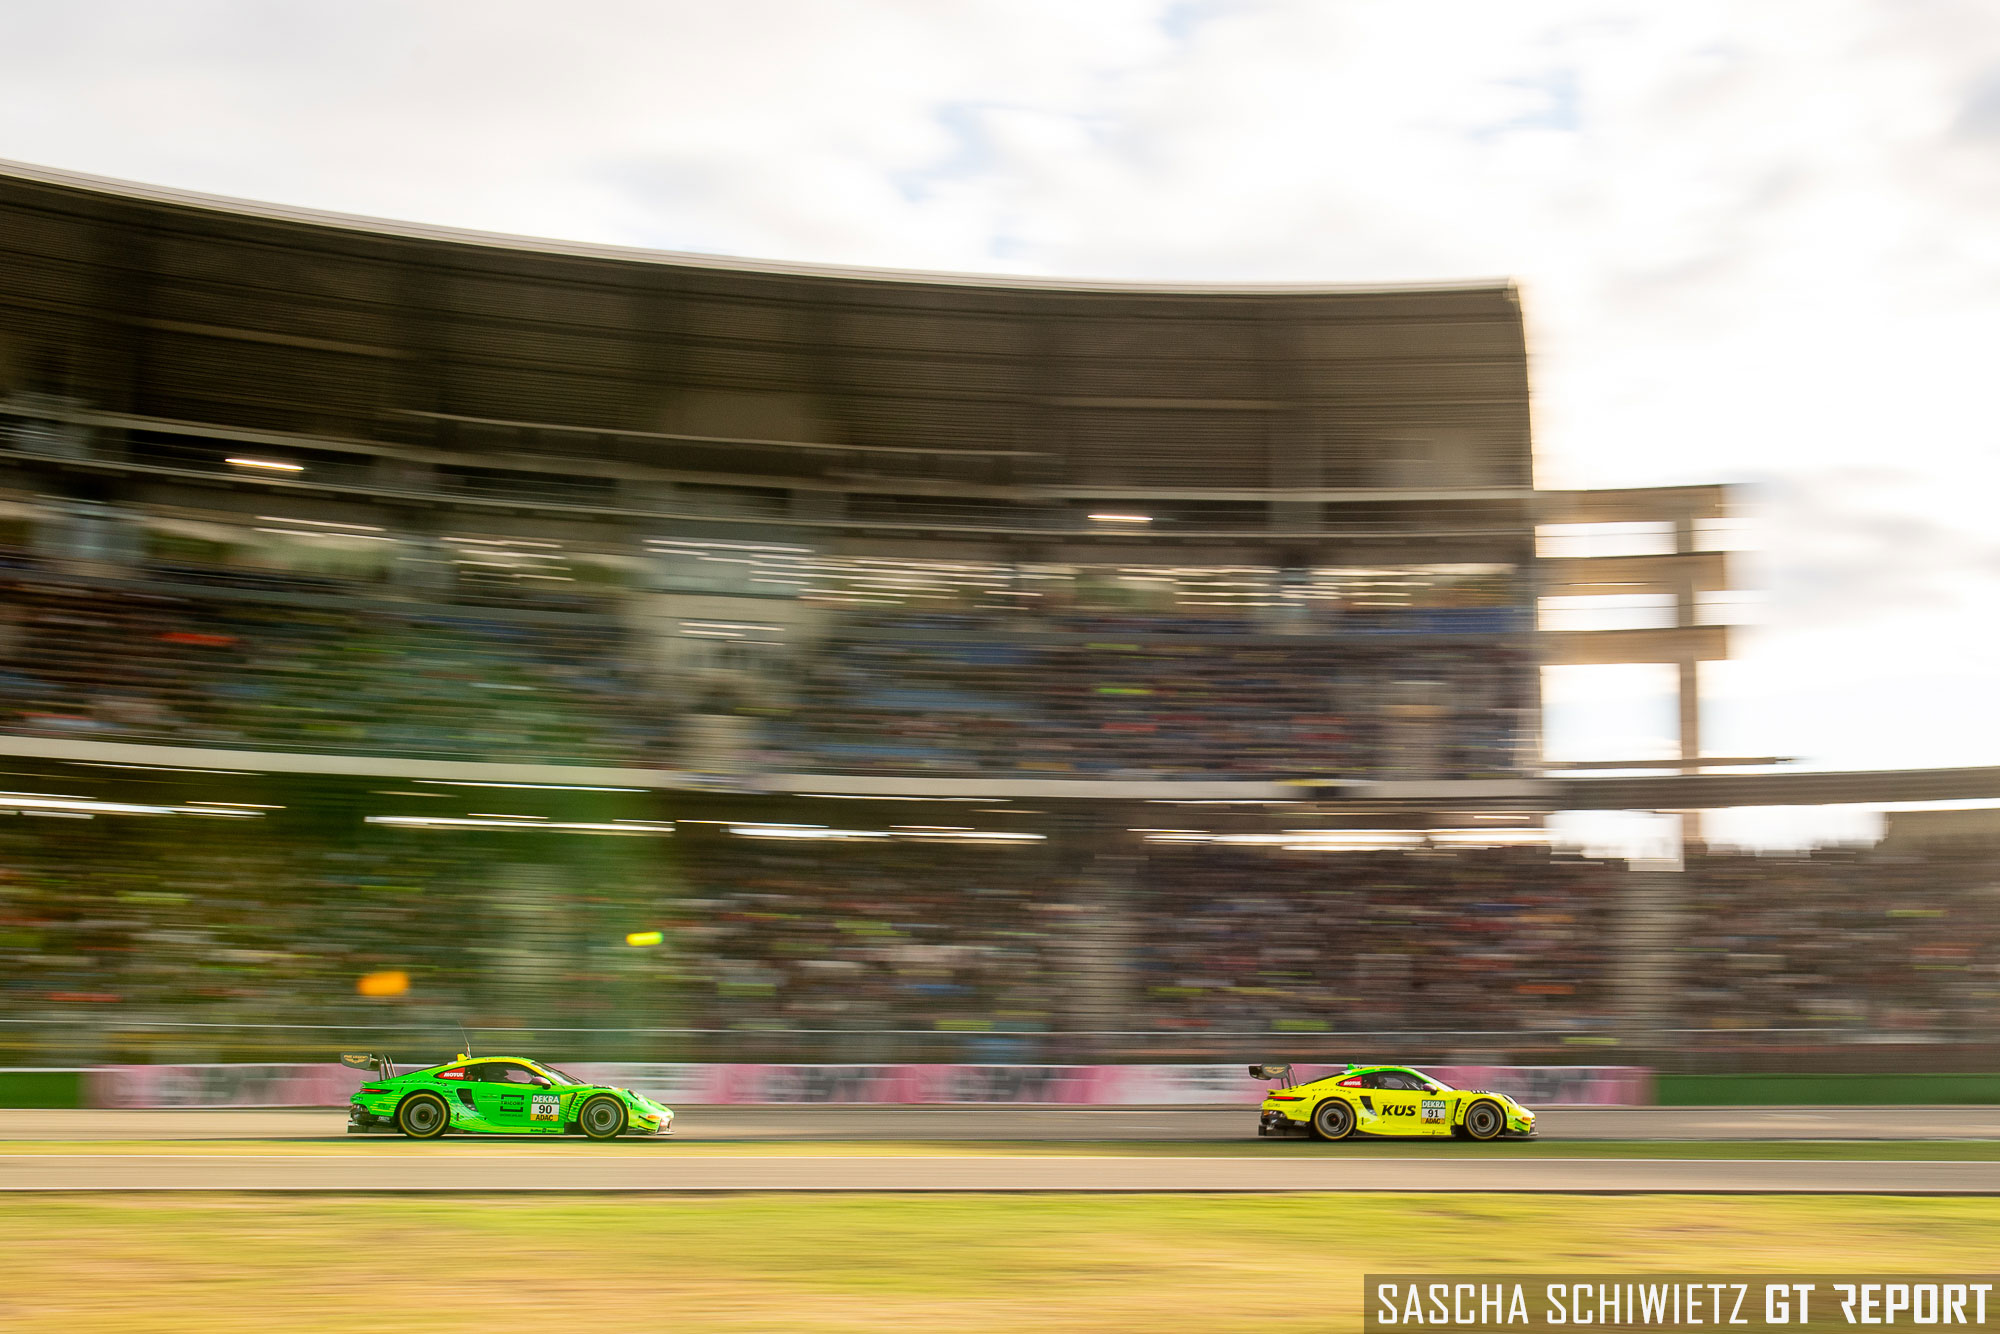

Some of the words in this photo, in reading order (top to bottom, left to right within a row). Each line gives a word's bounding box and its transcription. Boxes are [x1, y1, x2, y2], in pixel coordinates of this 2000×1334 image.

[532, 1094, 559, 1104] DEKRA
[538, 1104, 553, 1114] 90
[1427, 1109, 1440, 1118] 91
